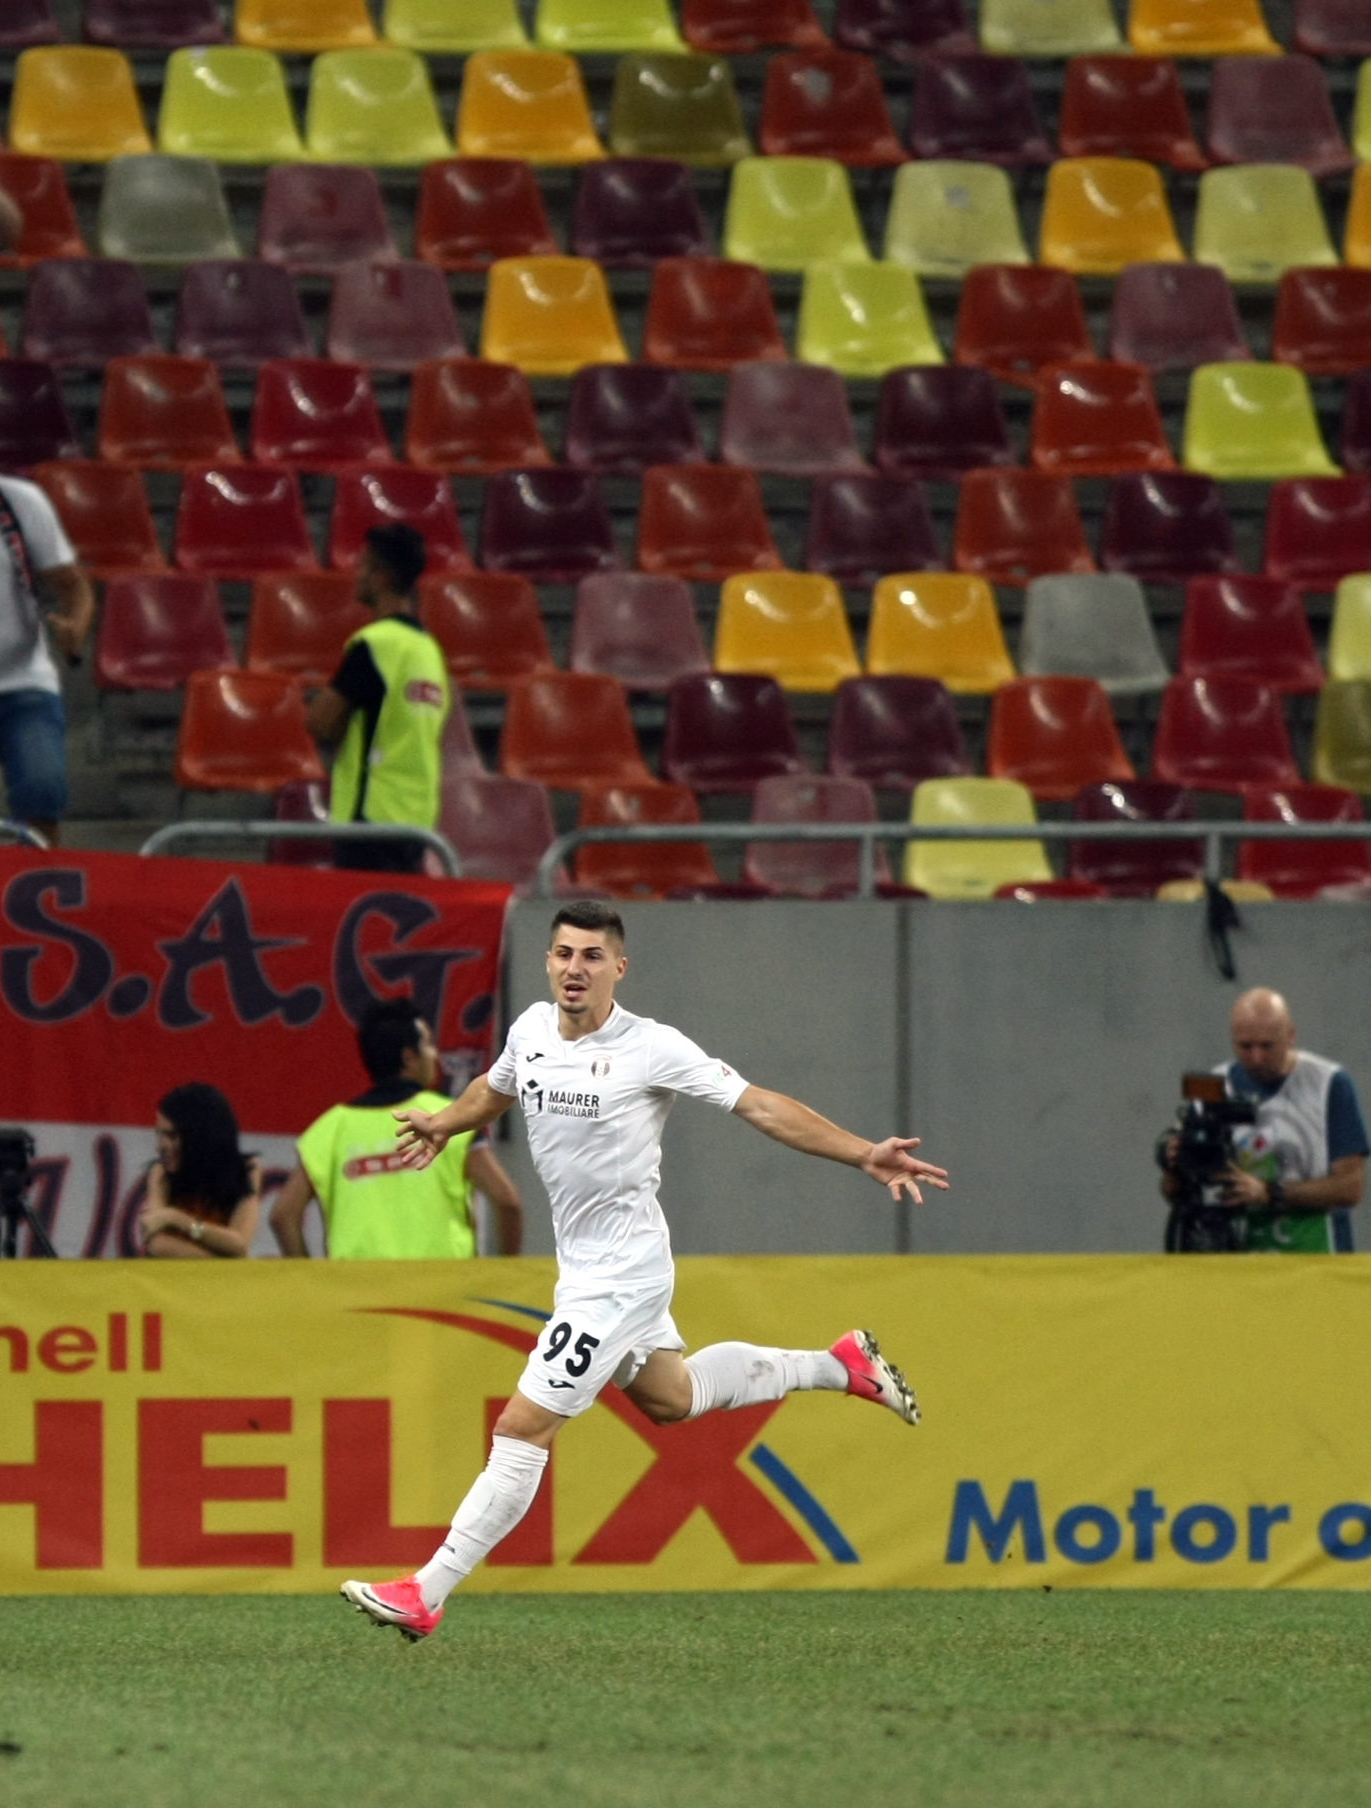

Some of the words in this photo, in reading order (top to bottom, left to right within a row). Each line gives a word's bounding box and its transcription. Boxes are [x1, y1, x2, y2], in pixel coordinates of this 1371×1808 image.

[547, 1103, 600, 1119] IMOBILIARE
[548, 1089, 600, 1108] MAURER
[543, 1321, 600, 1378] 95
[944, 1479, 1290, 1564] Motor
